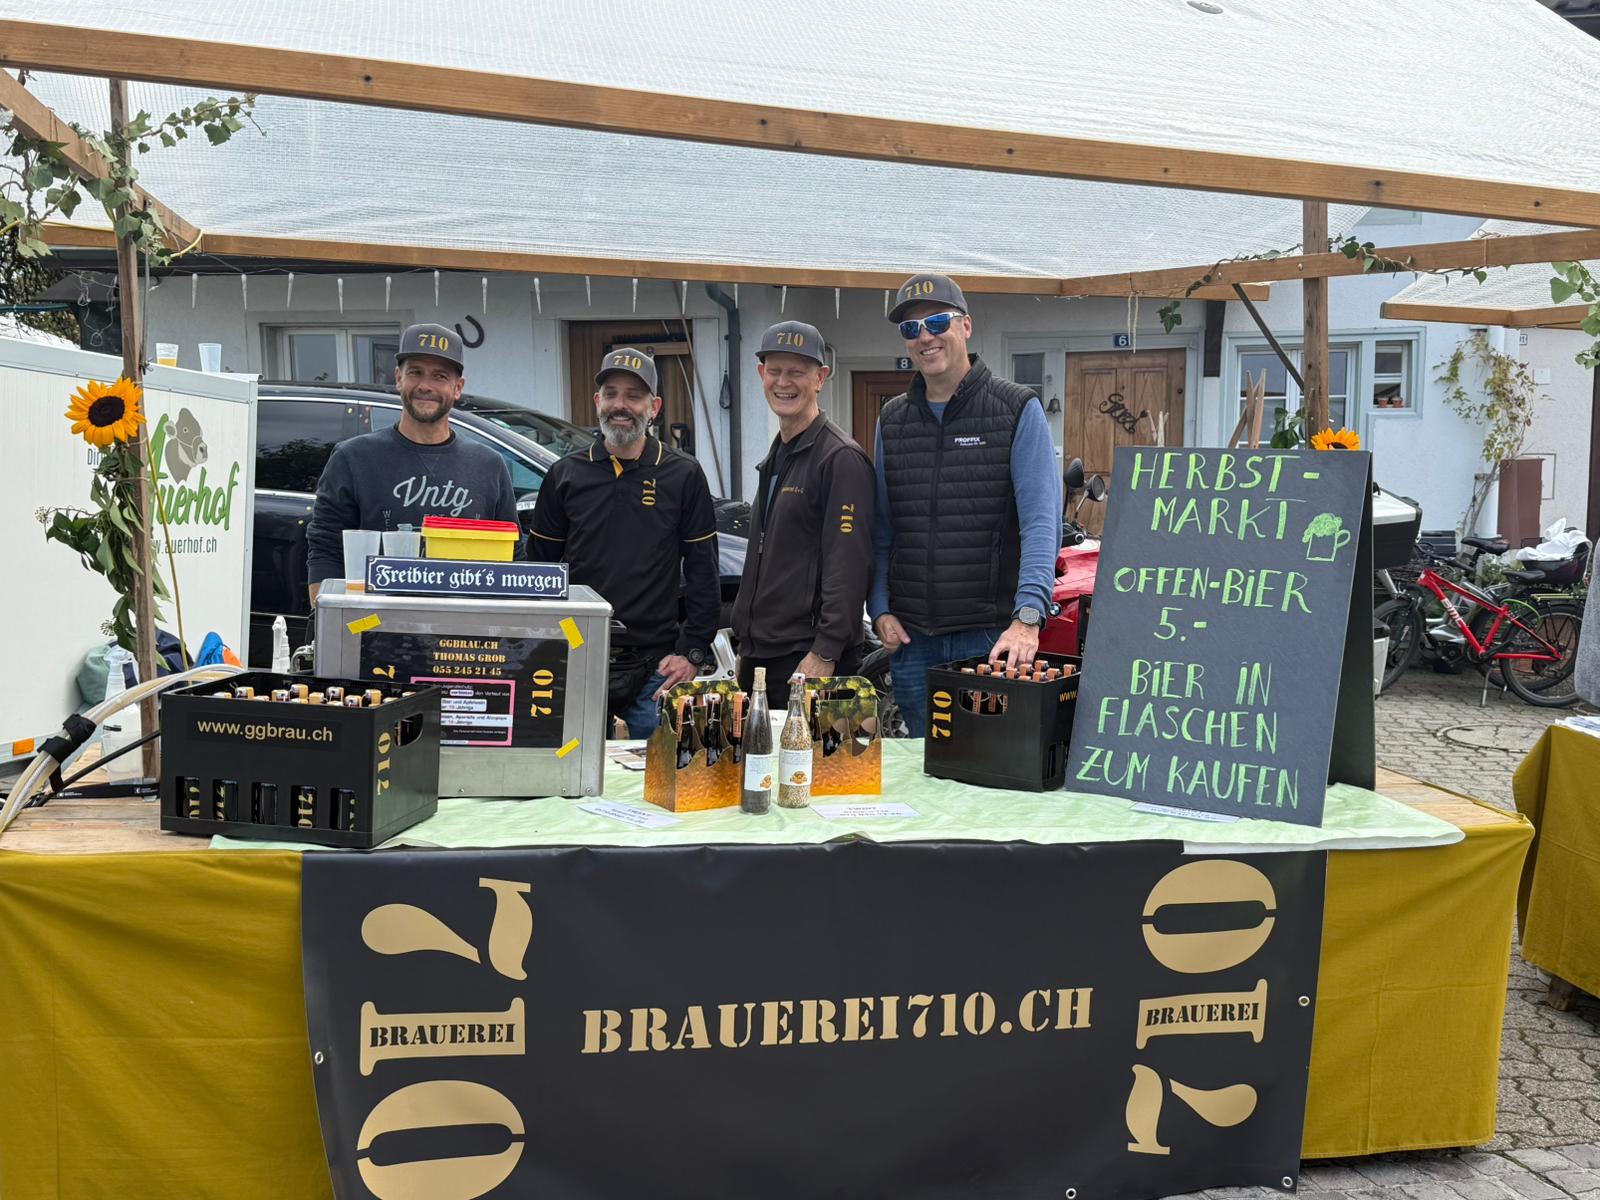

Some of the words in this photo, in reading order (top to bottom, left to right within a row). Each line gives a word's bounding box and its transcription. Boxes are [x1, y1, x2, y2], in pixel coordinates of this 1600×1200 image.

[904, 279, 934, 298] 710
[417, 333, 449, 352] 710
[775, 331, 804, 348] 710
[1118, 335, 1127, 346] 6
[613, 354, 642, 370] 710
[900, 358, 909, 369] 8
[393, 475, 473, 517] Vntg
[640, 478, 657, 506] 710
[840, 503, 854, 533] 710
[1150, 496, 1306, 540] MARKT
[375, 564, 445, 586] Freibier
[501, 574, 562, 591] morgen
[1153, 606, 1207, 642] 5.-
[433, 652, 476, 662] THOMAS
[478, 653, 506, 663] GROB
[439, 639, 499, 650] GGBRAU.CH
[432, 665, 452, 675] 055
[453, 666, 473, 675] 245
[475, 667, 486, 676] 21
[489, 667, 502, 676] 45
[531, 669, 554, 718] 710
[931, 690, 952, 739] 710
[1097, 697, 1278, 754] FLASCHEN
[196, 719, 333, 743] www.ggbrau.ch
[377, 732, 391, 796] 710
[1076, 745, 1151, 791] ZUM
[1165, 755, 1299, 810] KAUFEN
[580, 987, 1095, 1054] BRAUEREI710.CH
[1126, 859, 1277, 1155] 710
[1144, 1002, 1260, 1027] BRAUEREI
[357, 877, 534, 1200] 710
[369, 1022, 516, 1048] BRAUEREI
